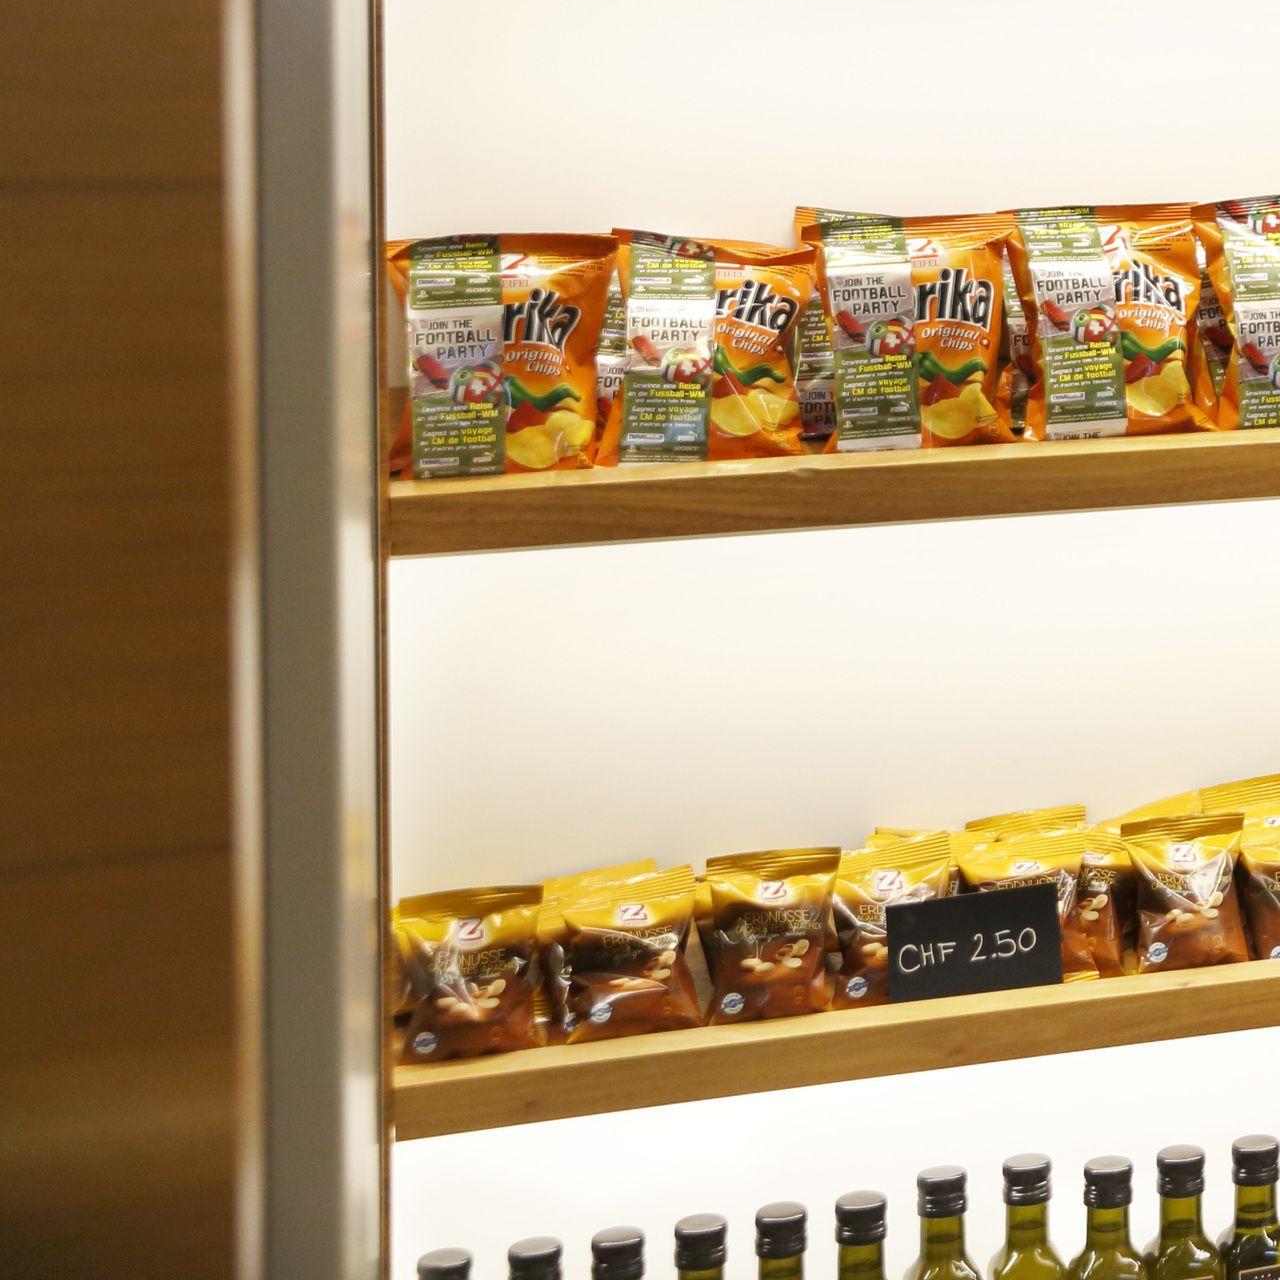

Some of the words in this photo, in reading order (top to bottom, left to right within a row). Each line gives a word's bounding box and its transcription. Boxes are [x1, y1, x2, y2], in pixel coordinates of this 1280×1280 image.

[844, 277, 863, 286] JOIN
[865, 276, 884, 285] THE
[1037, 277, 1107, 292] FOOTBALL
[833, 286, 906, 302] FOOTBALL
[1057, 290, 1101, 305] PARTY
[853, 301, 899, 315] PARTY
[1249, 311, 1267, 320] JOIN
[427, 320, 449, 330] JOIN
[453, 320, 472, 328] THE
[631, 316, 708, 329] FOOTBALL
[416, 329, 496, 345] FOOTBALL
[651, 330, 700, 341] PARTY
[718, 324, 775, 345] Original
[921, 325, 981, 340] Original
[732, 338, 768, 356] Chips
[940, 337, 974, 351] Chips
[437, 344, 489, 360] PARTY
[506, 349, 563, 365] Original
[1064, 347, 1116, 359] Fussball-WM
[527, 361, 561, 376] Chips
[1084, 363, 1112, 371] voyage
[1086, 370, 1116, 379] football
[899, 941, 957, 972] CHF
[971, 927, 1037, 961] 2.50
